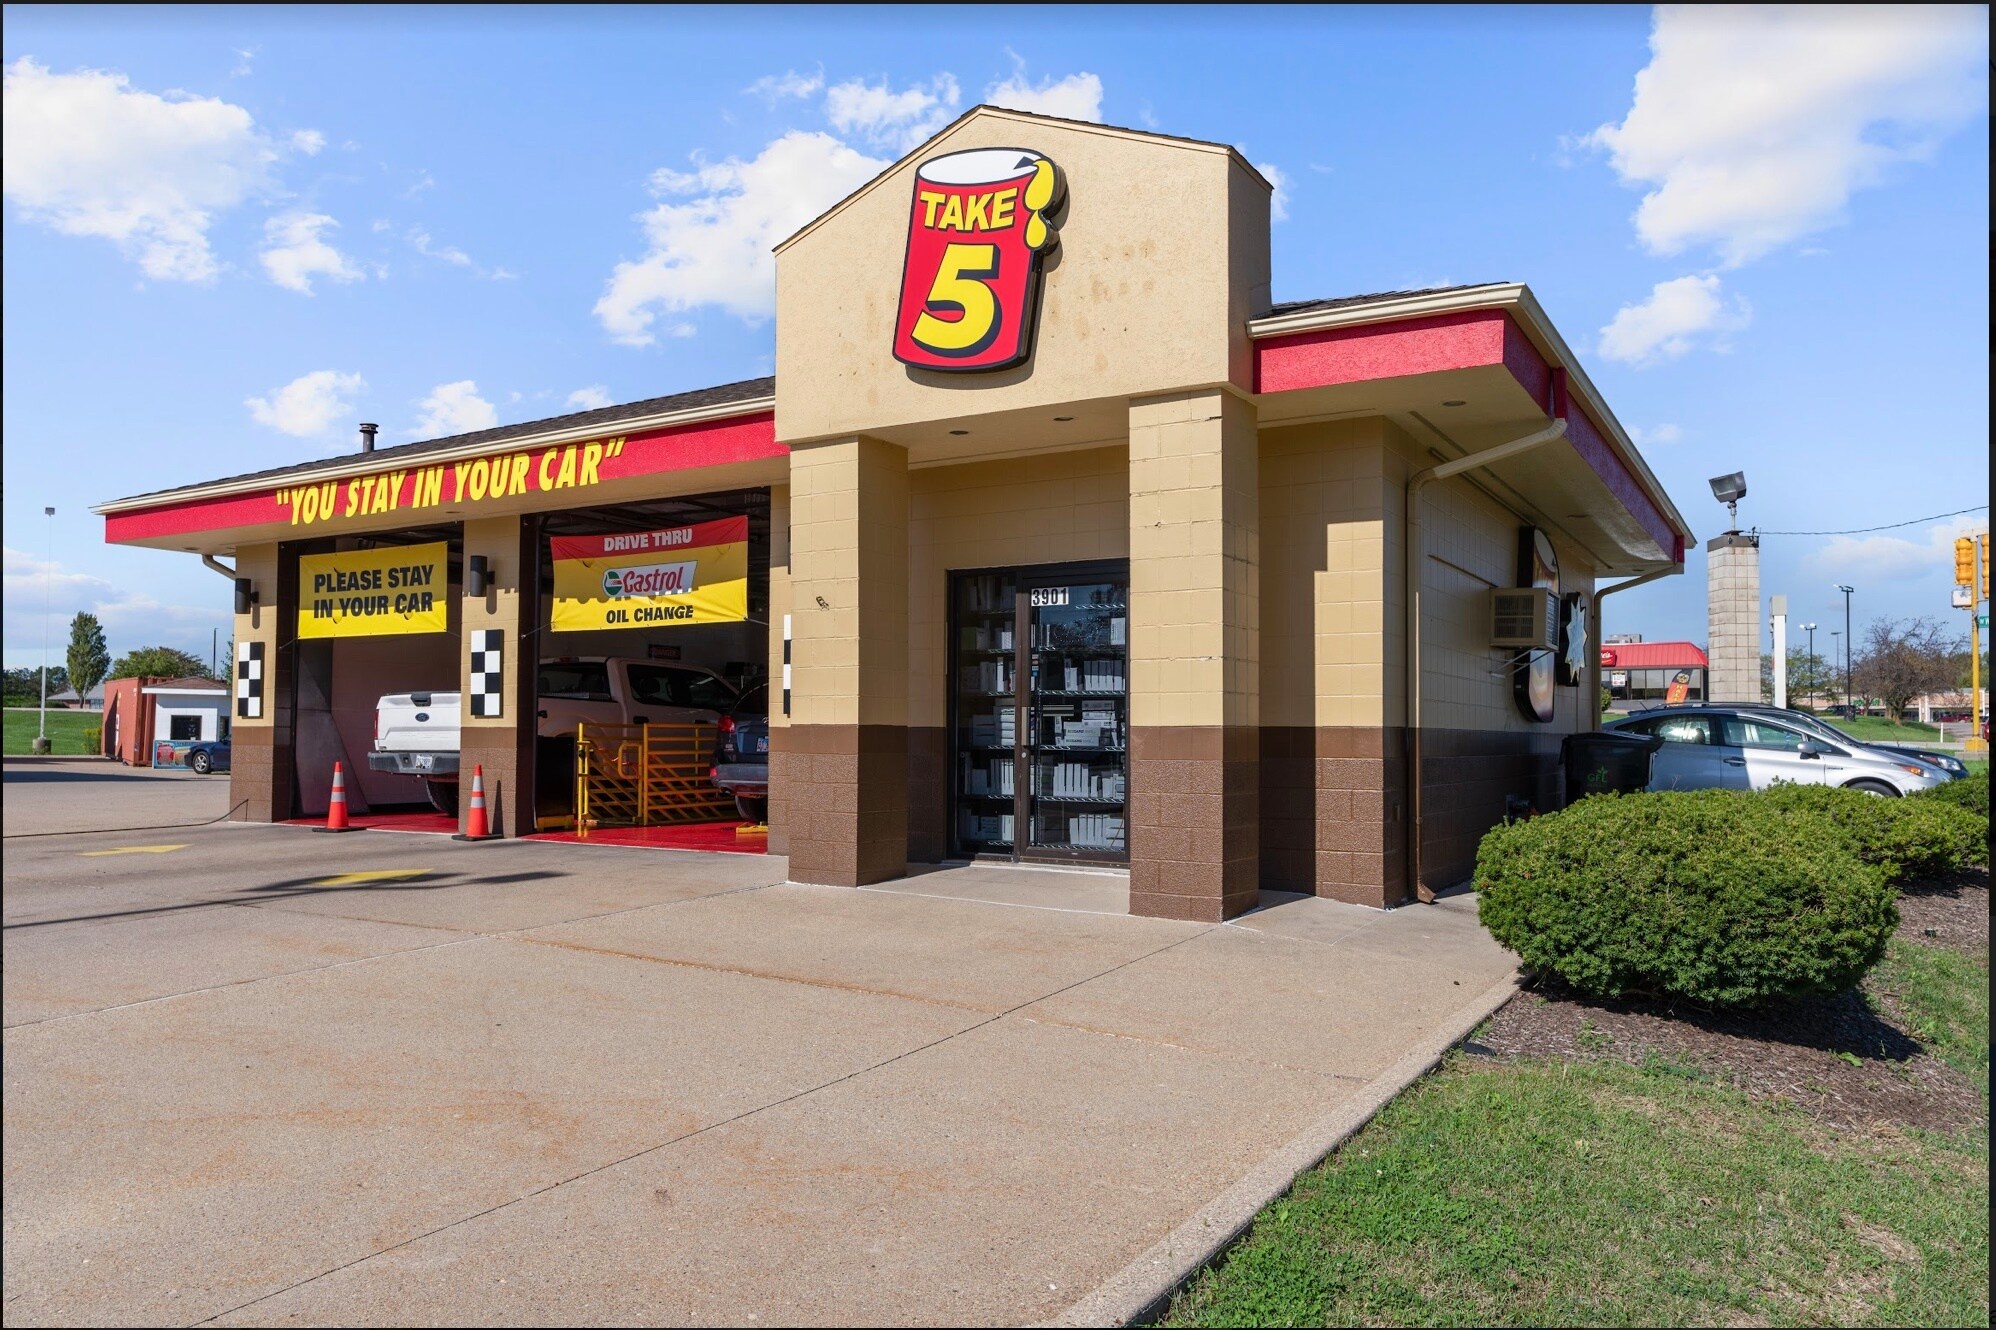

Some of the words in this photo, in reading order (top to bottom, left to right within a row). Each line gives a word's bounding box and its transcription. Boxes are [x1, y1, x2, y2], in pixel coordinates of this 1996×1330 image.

[919, 186, 1018, 232] TAKE
[911, 243, 1002, 356] 5
[345, 470, 408, 518] STAY
[412, 466, 445, 509] IN
[454, 452, 531, 503] YOUR
[604, 534, 649, 552] DRIVE
[652, 528, 693, 546] THRU
[314, 569, 383, 593] PLEASE
[388, 564, 434, 588] STAY
[623, 566, 684, 593] Castrol
[313, 598, 333, 619] IN
[339, 595, 389, 617] YOUR
[394, 591, 433, 614] CAR
[1032, 588, 1066, 605] 3901
[606, 609, 629, 624] OIL
[634, 605, 693, 622] CHANGE
